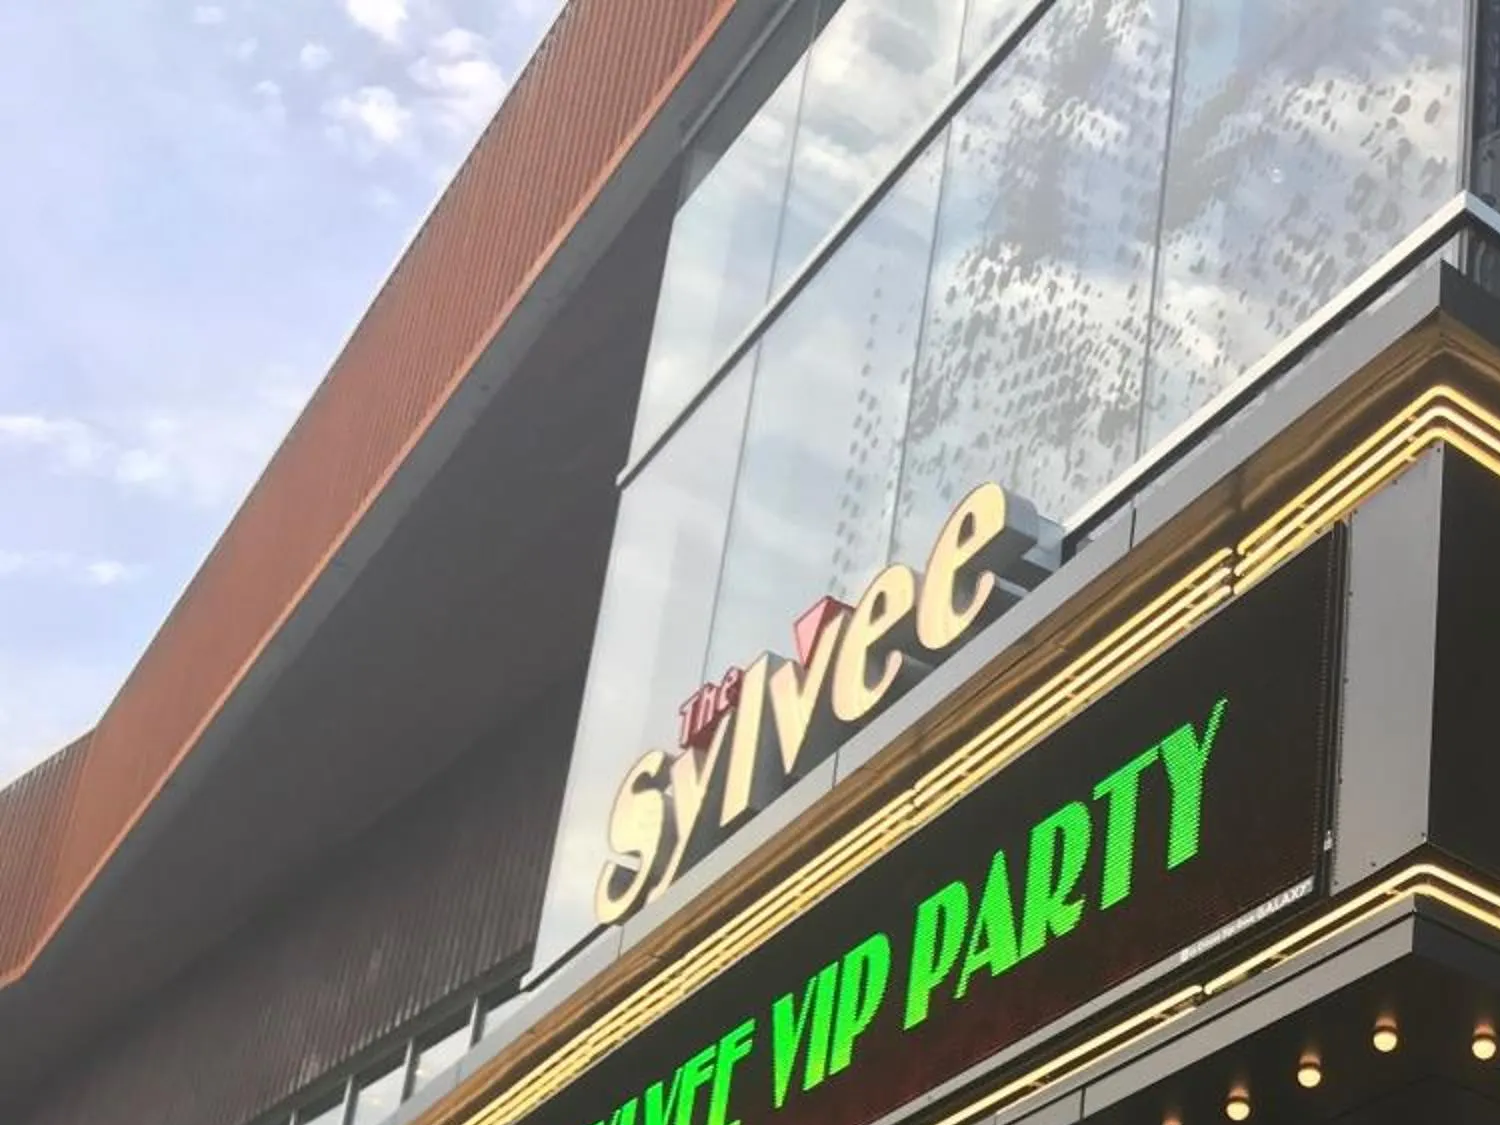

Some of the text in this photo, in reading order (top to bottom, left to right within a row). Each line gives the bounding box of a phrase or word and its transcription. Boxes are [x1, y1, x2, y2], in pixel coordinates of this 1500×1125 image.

[594, 481, 1006, 925] Sylvee
[677, 665, 742, 748] The
[771, 931, 892, 1109] VIP
[902, 697, 1228, 1031] PARTY
